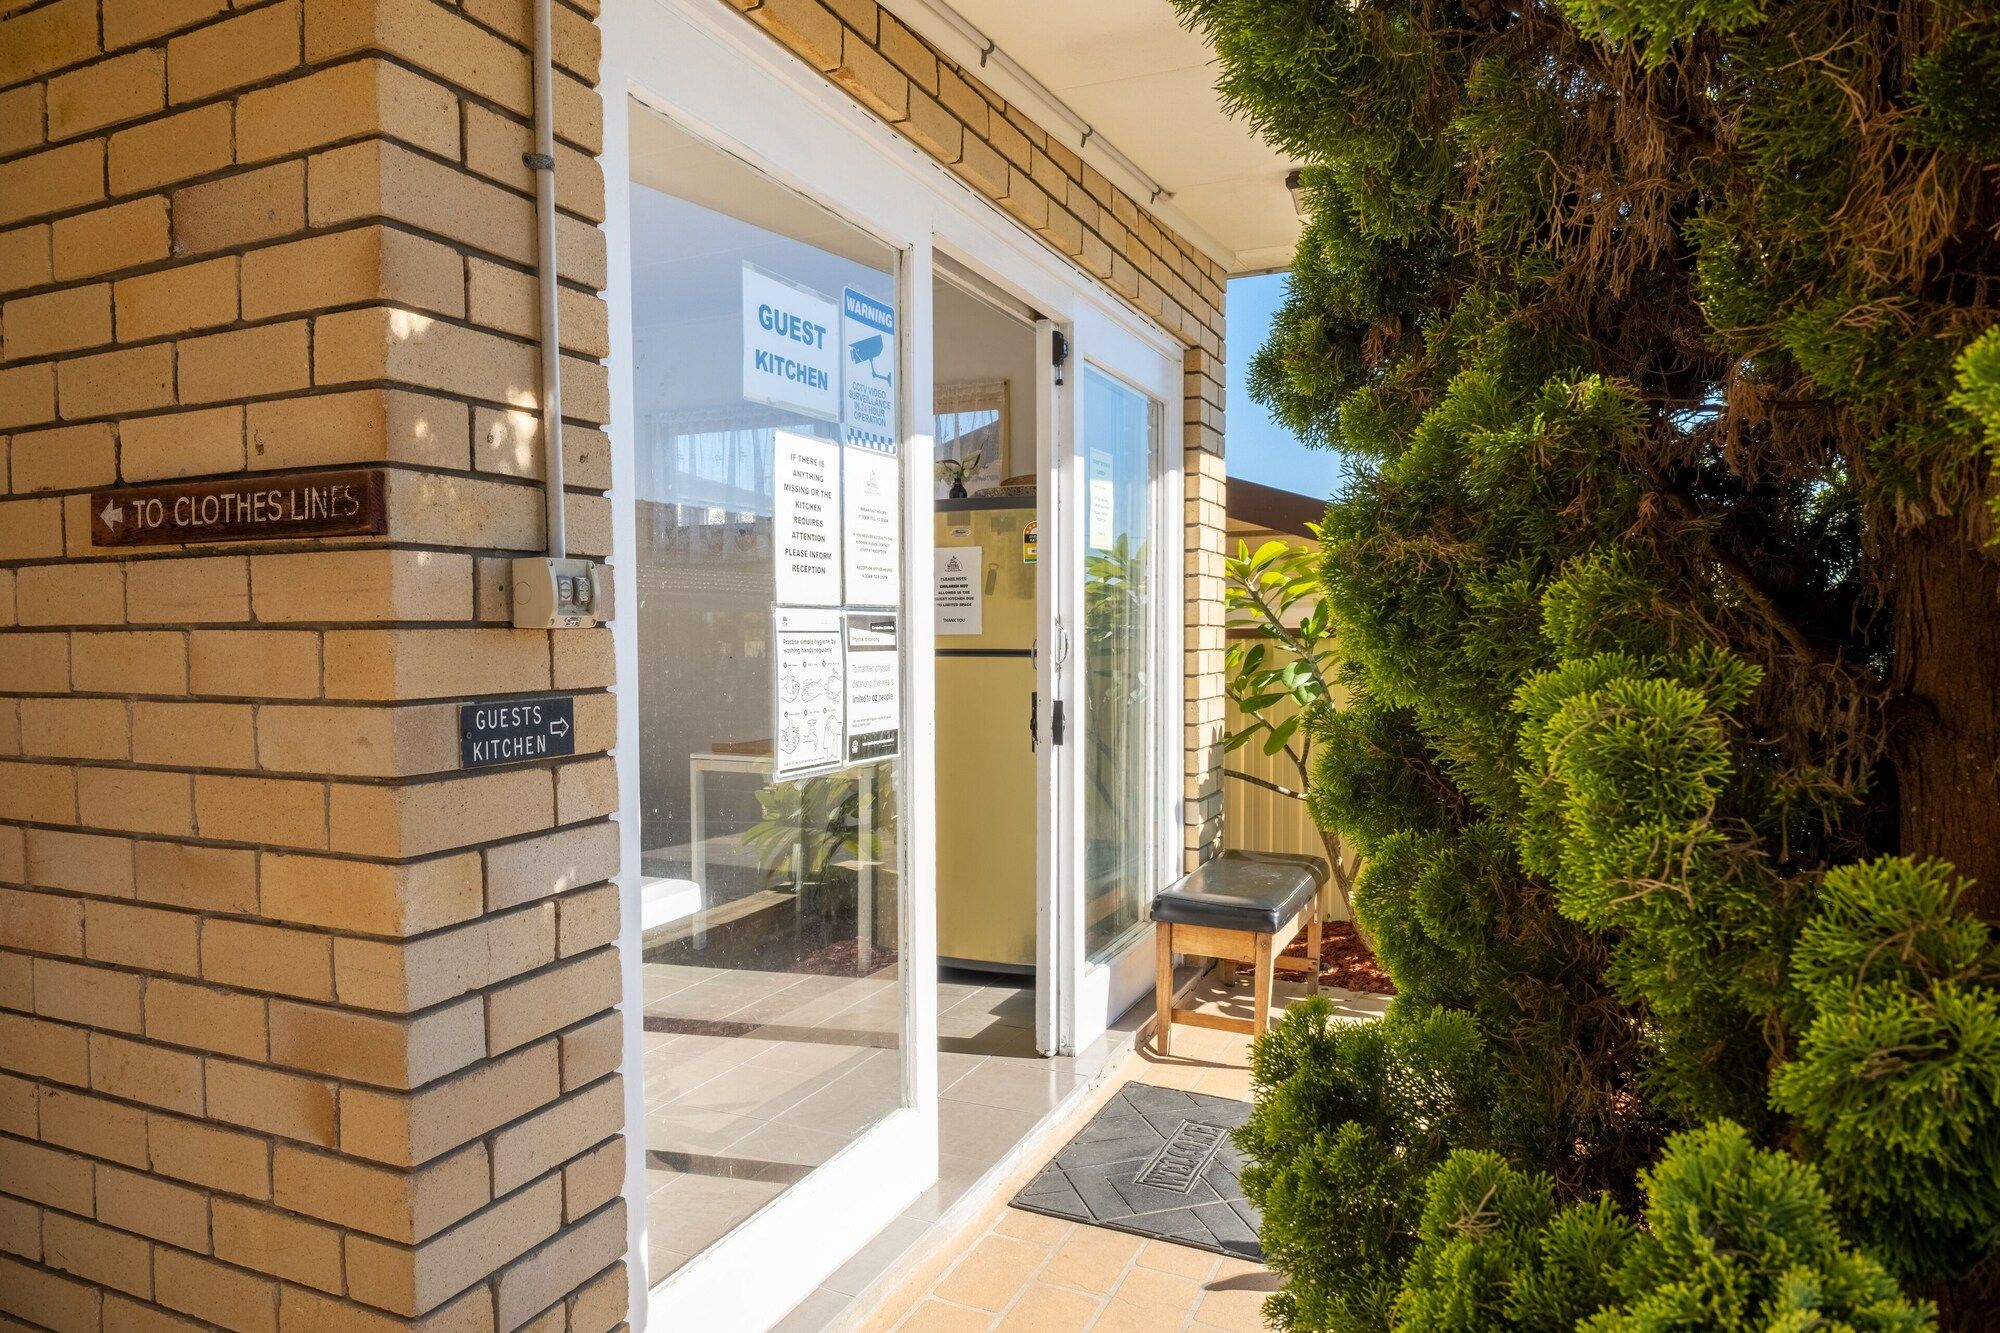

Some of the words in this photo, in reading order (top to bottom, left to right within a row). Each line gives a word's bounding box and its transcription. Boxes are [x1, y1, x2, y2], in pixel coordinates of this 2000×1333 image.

[846, 296, 892, 328] WARNING
[758, 304, 826, 349] GUEST
[755, 349, 828, 390] KITCHEN
[852, 381, 866, 392] CCTV
[868, 387, 886, 399] VIDEO
[848, 389, 891, 409] SURVEILLANCE
[854, 411, 886, 427] OPERATION
[868, 406, 885, 417] HOUR
[790, 453, 796, 461] IF
[798, 455, 817, 466] THERE
[819, 460, 825, 468] IS
[792, 469, 824, 483] ANYTHING
[783, 483, 809, 495] MISSING
[811, 488, 819, 497] OR
[821, 490, 832, 499] THE
[133, 499, 163, 528] TO
[174, 490, 282, 527] CLOTHES
[291, 485, 359, 520] LINES
[795, 501, 822, 512] KITCHEN
[793, 516, 824, 528] REQUIRES
[791, 531, 826, 543] ATTENTION
[785, 548, 808, 558] PLEASE
[809, 551, 832, 560] INFORM
[792, 564, 826, 574] RECEPTION
[814, 638, 830, 646] hygiene
[852, 693, 866, 703] limited
[476, 706, 541, 730] GUESTS
[473, 735, 546, 761] KITCHEN
[1141, 1124, 1219, 1187] WELCOME
